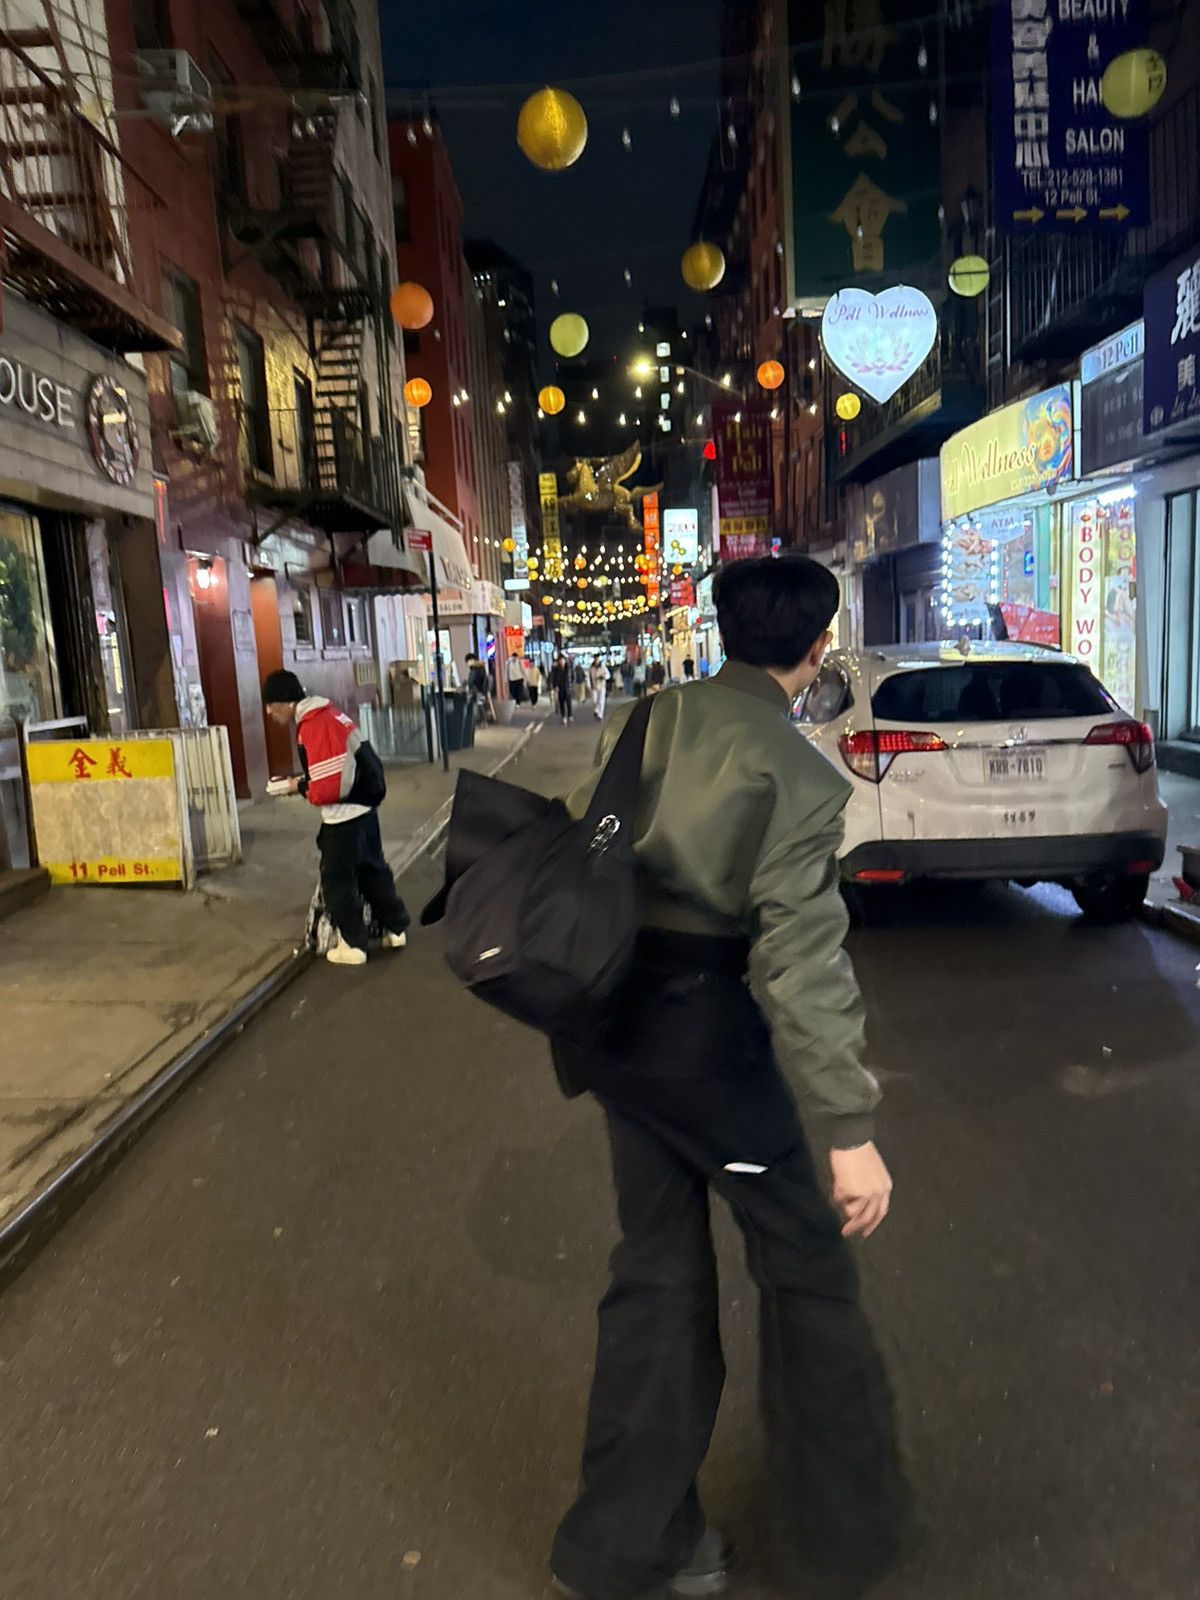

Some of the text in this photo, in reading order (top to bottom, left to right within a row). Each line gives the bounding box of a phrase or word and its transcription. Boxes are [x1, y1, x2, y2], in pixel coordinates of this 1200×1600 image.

[1059, 0, 1129, 21] BEAUTY
[1087, 34, 1099, 60] &
[1073, 77, 1104, 106] HAI
[1065, 127, 1125, 155] SALON
[1045, 189, 1057, 206] 12
[829, 302, 929, 325] Pell Wellness
[1115, 333, 1139, 362] Pell
[0, 357, 75, 427] OUSE
[961, 438, 1037, 484] Wellness
[1076, 526, 1095, 659] BODY WO
[69, 862, 154, 880] 11 Pell St.
